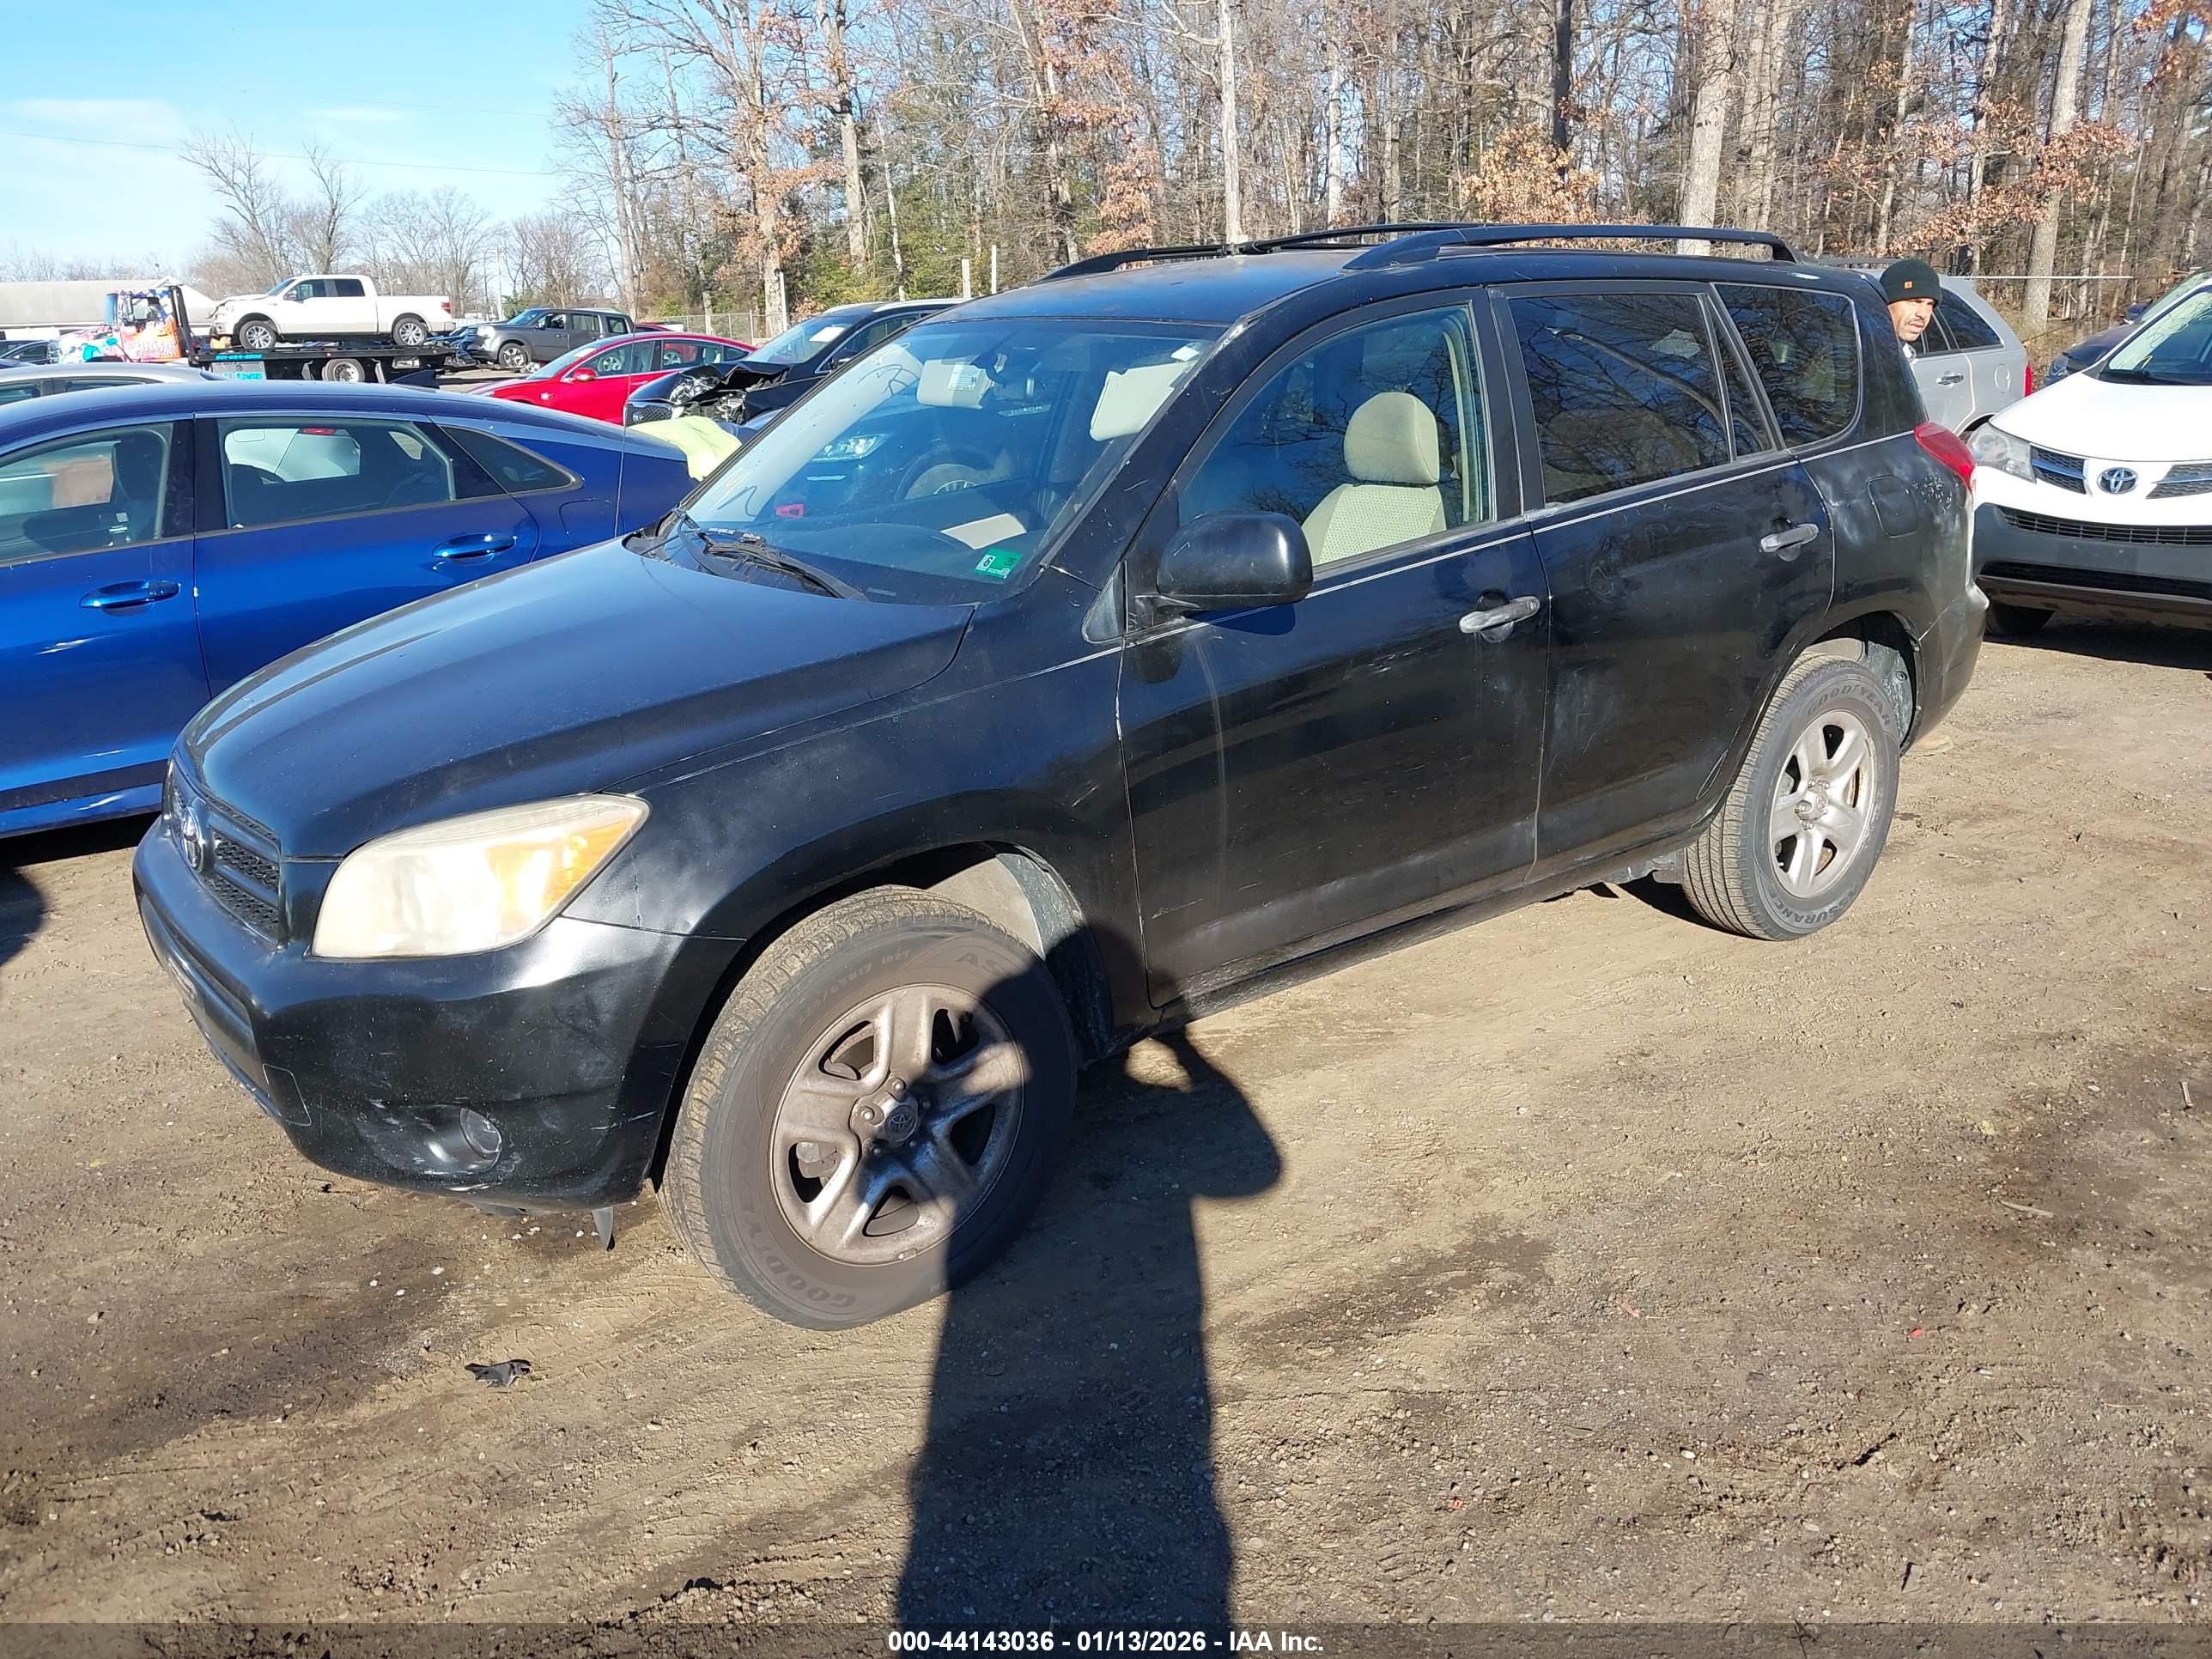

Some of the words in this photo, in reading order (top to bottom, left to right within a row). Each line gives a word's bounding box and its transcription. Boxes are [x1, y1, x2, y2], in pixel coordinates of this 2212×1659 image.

[982, 556, 994, 567] 6
[1003, 556, 1017, 566] 26
[1807, 684, 1891, 726] GOODYEAR
[738, 1127, 857, 1308] GOODYEAR
